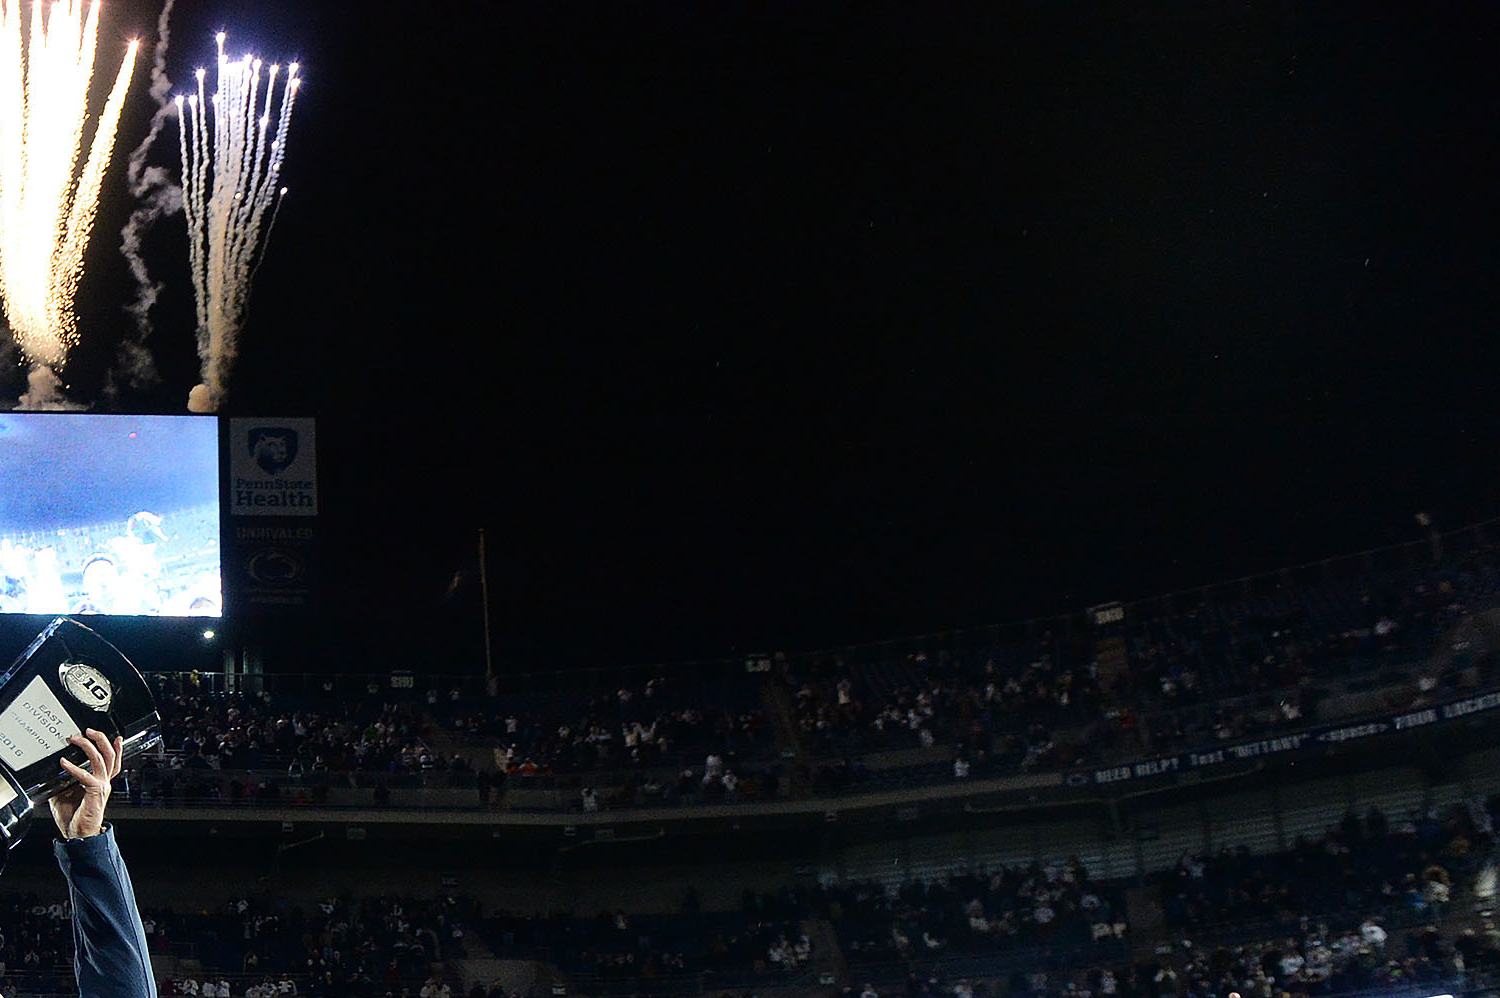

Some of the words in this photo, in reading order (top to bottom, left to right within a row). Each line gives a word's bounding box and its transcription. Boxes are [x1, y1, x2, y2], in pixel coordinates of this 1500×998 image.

[235, 478, 313, 490] PennState
[235, 490, 314, 507] Health
[22, 701, 65, 743] DIVISION
[38, 704, 64, 726] EAST
[11, 711, 51, 750] CHAMPION
